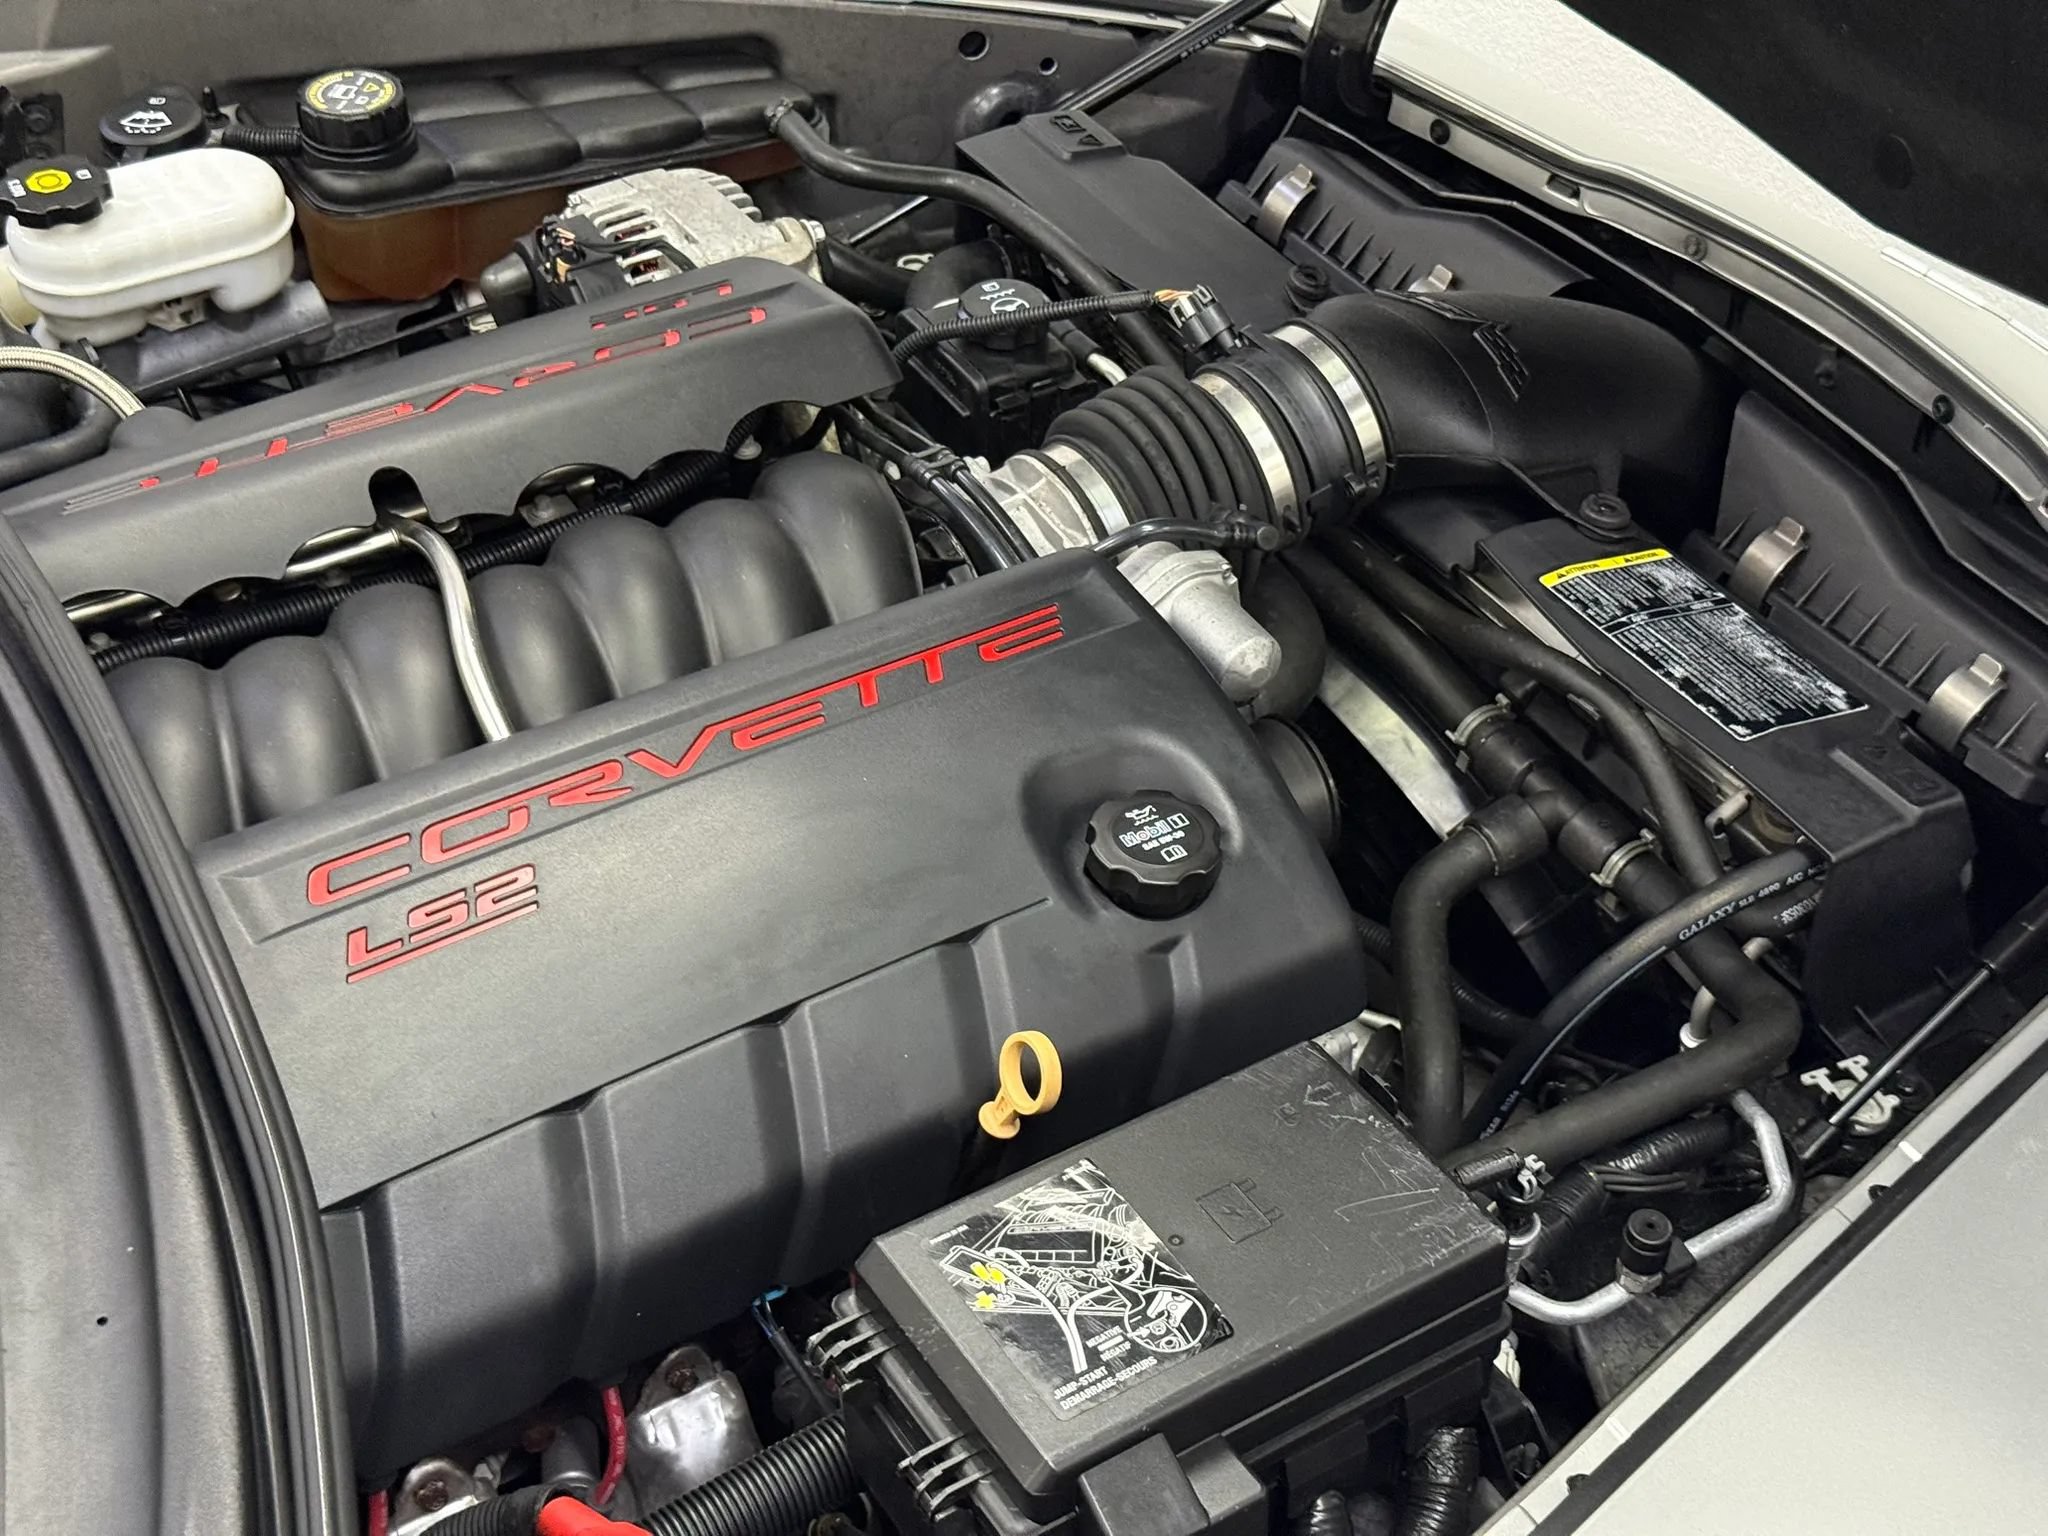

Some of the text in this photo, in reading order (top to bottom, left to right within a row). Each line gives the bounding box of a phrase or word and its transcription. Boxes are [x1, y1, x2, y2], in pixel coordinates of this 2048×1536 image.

[306, 603, 1066, 908] CORVETTE
[1119, 820, 1171, 847] Mobil
[345, 864, 539, 968] LS2
[1678, 902, 1736, 941] GALAXY
[1758, 882, 1780, 898] 4890
[1786, 872, 1804, 886] A/C
[1086, 1326, 1123, 1348] NEGATIVE
[1054, 1366, 1108, 1400] JUMP-START
[1060, 1356, 1158, 1410] DEMARRAGE-SECOURS
